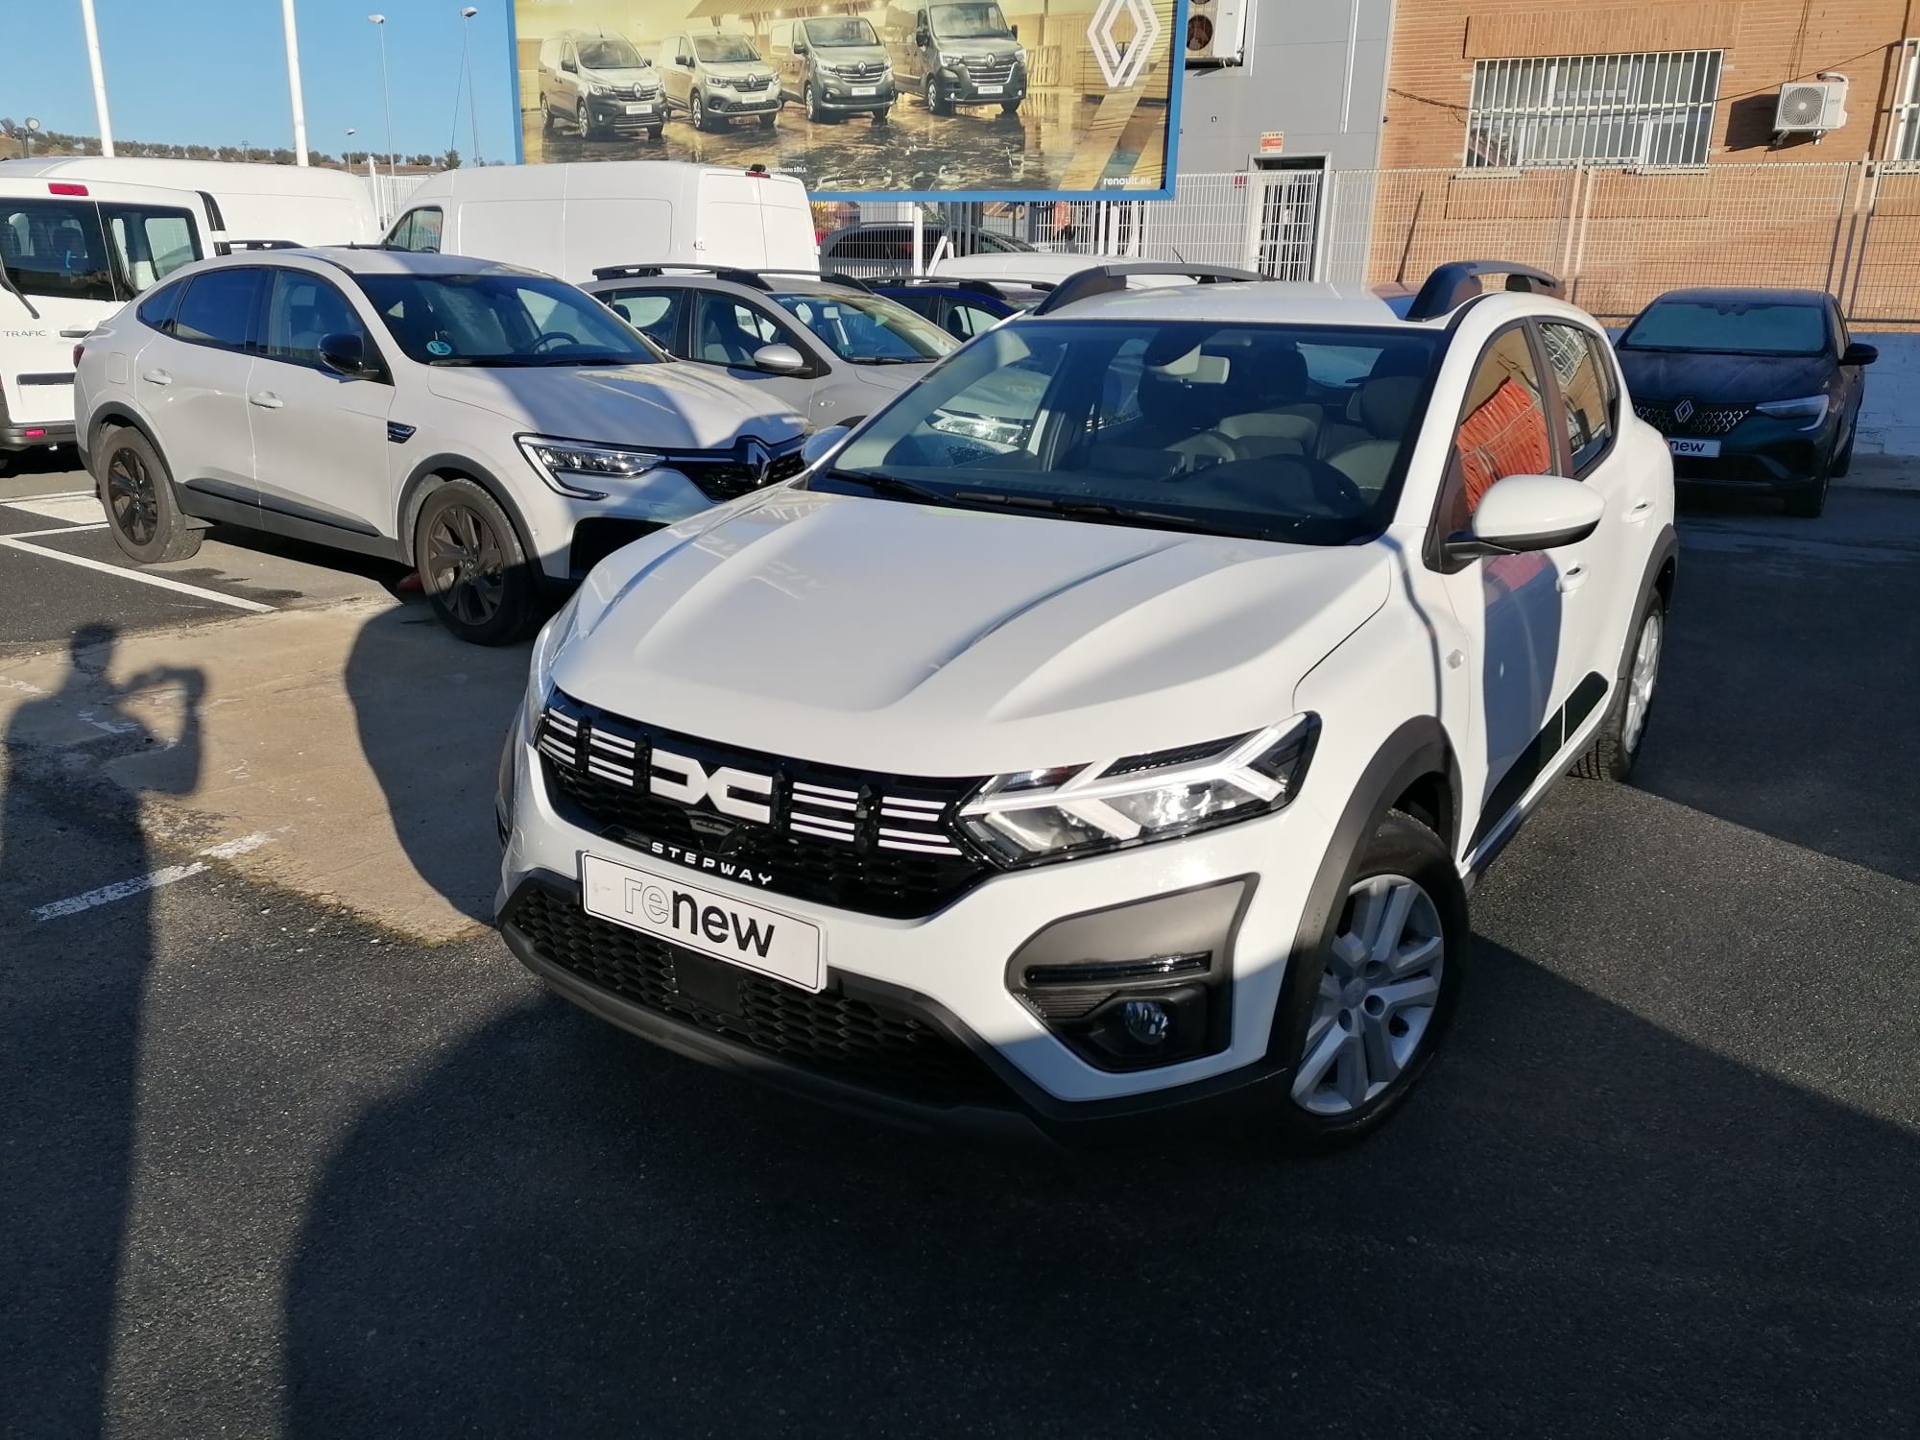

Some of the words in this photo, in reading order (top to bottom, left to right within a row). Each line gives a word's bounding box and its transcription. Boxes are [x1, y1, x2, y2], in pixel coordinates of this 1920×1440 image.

[1103, 176, 1152, 186] renault.es
[651, 842, 772, 885] STEPWAY
[624, 877, 775, 958] renew
